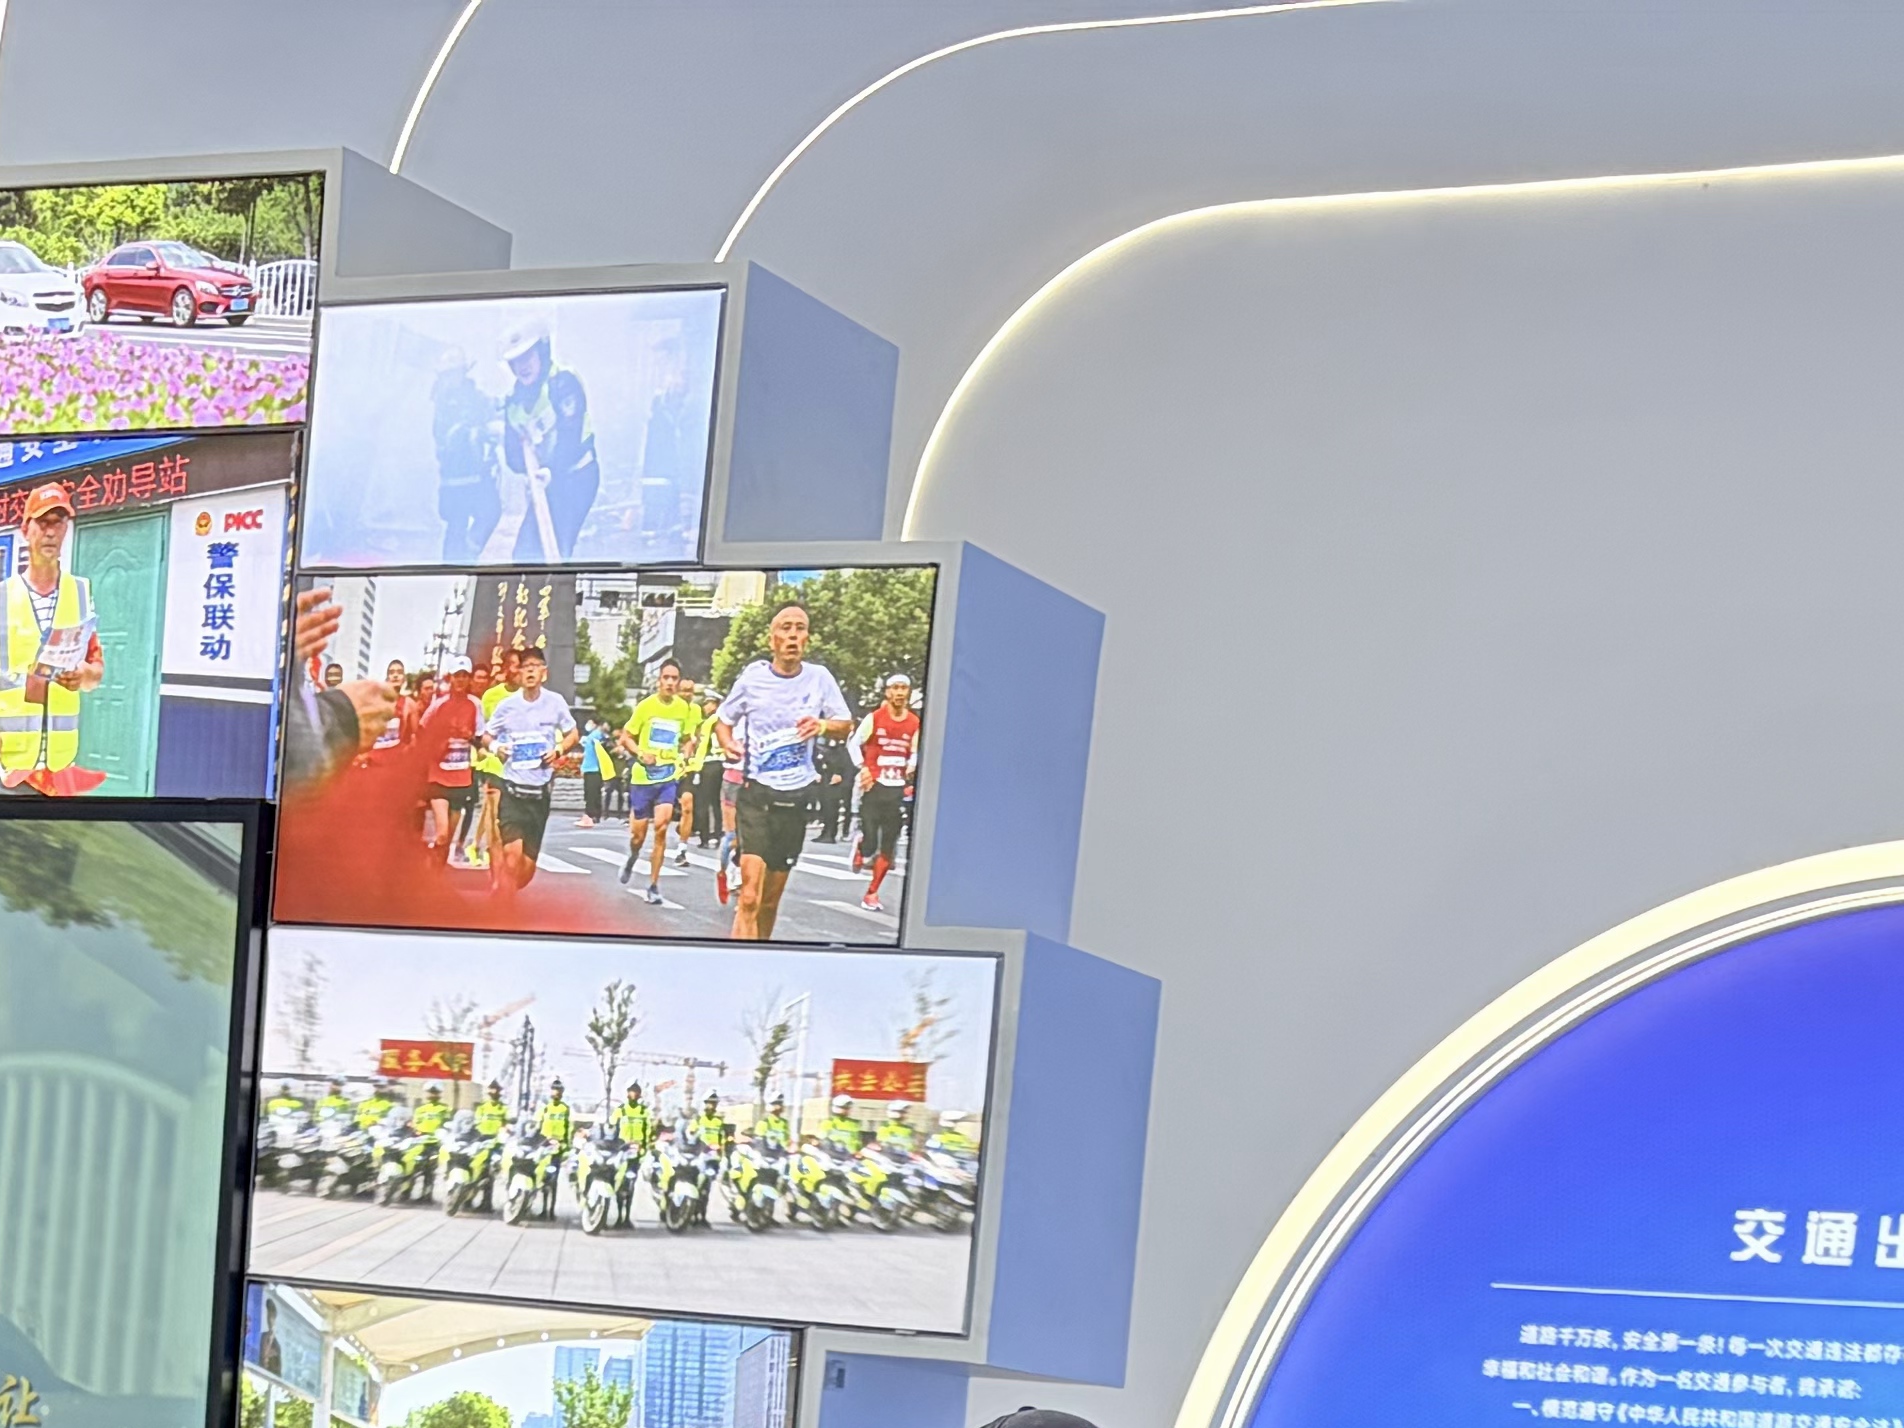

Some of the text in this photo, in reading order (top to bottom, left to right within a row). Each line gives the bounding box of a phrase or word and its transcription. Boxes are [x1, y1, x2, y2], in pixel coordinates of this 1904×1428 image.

[224, 509, 264, 533] PICC
[199, 541, 240, 661] 警保联动
